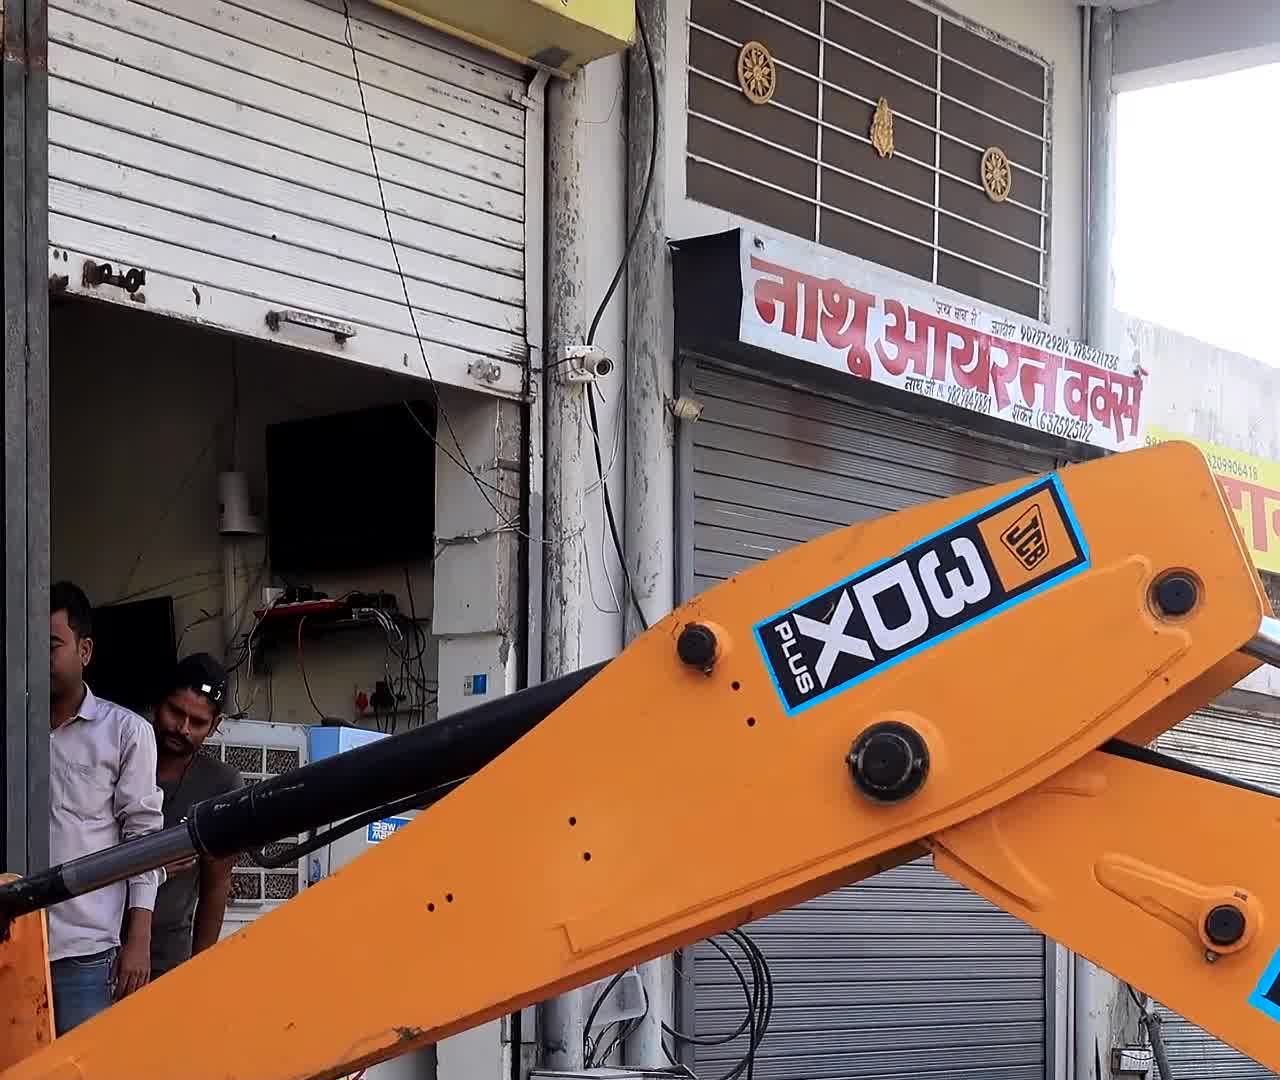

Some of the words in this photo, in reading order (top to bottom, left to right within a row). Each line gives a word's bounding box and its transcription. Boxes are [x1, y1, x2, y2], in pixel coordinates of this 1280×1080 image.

[751, 256, 875, 382] नाथू
[874, 298, 1061, 413] आयरन
[1012, 514, 1046, 567] JCB
[774, 620, 815, 695] PLUS
[792, 537, 992, 689] 3DX
